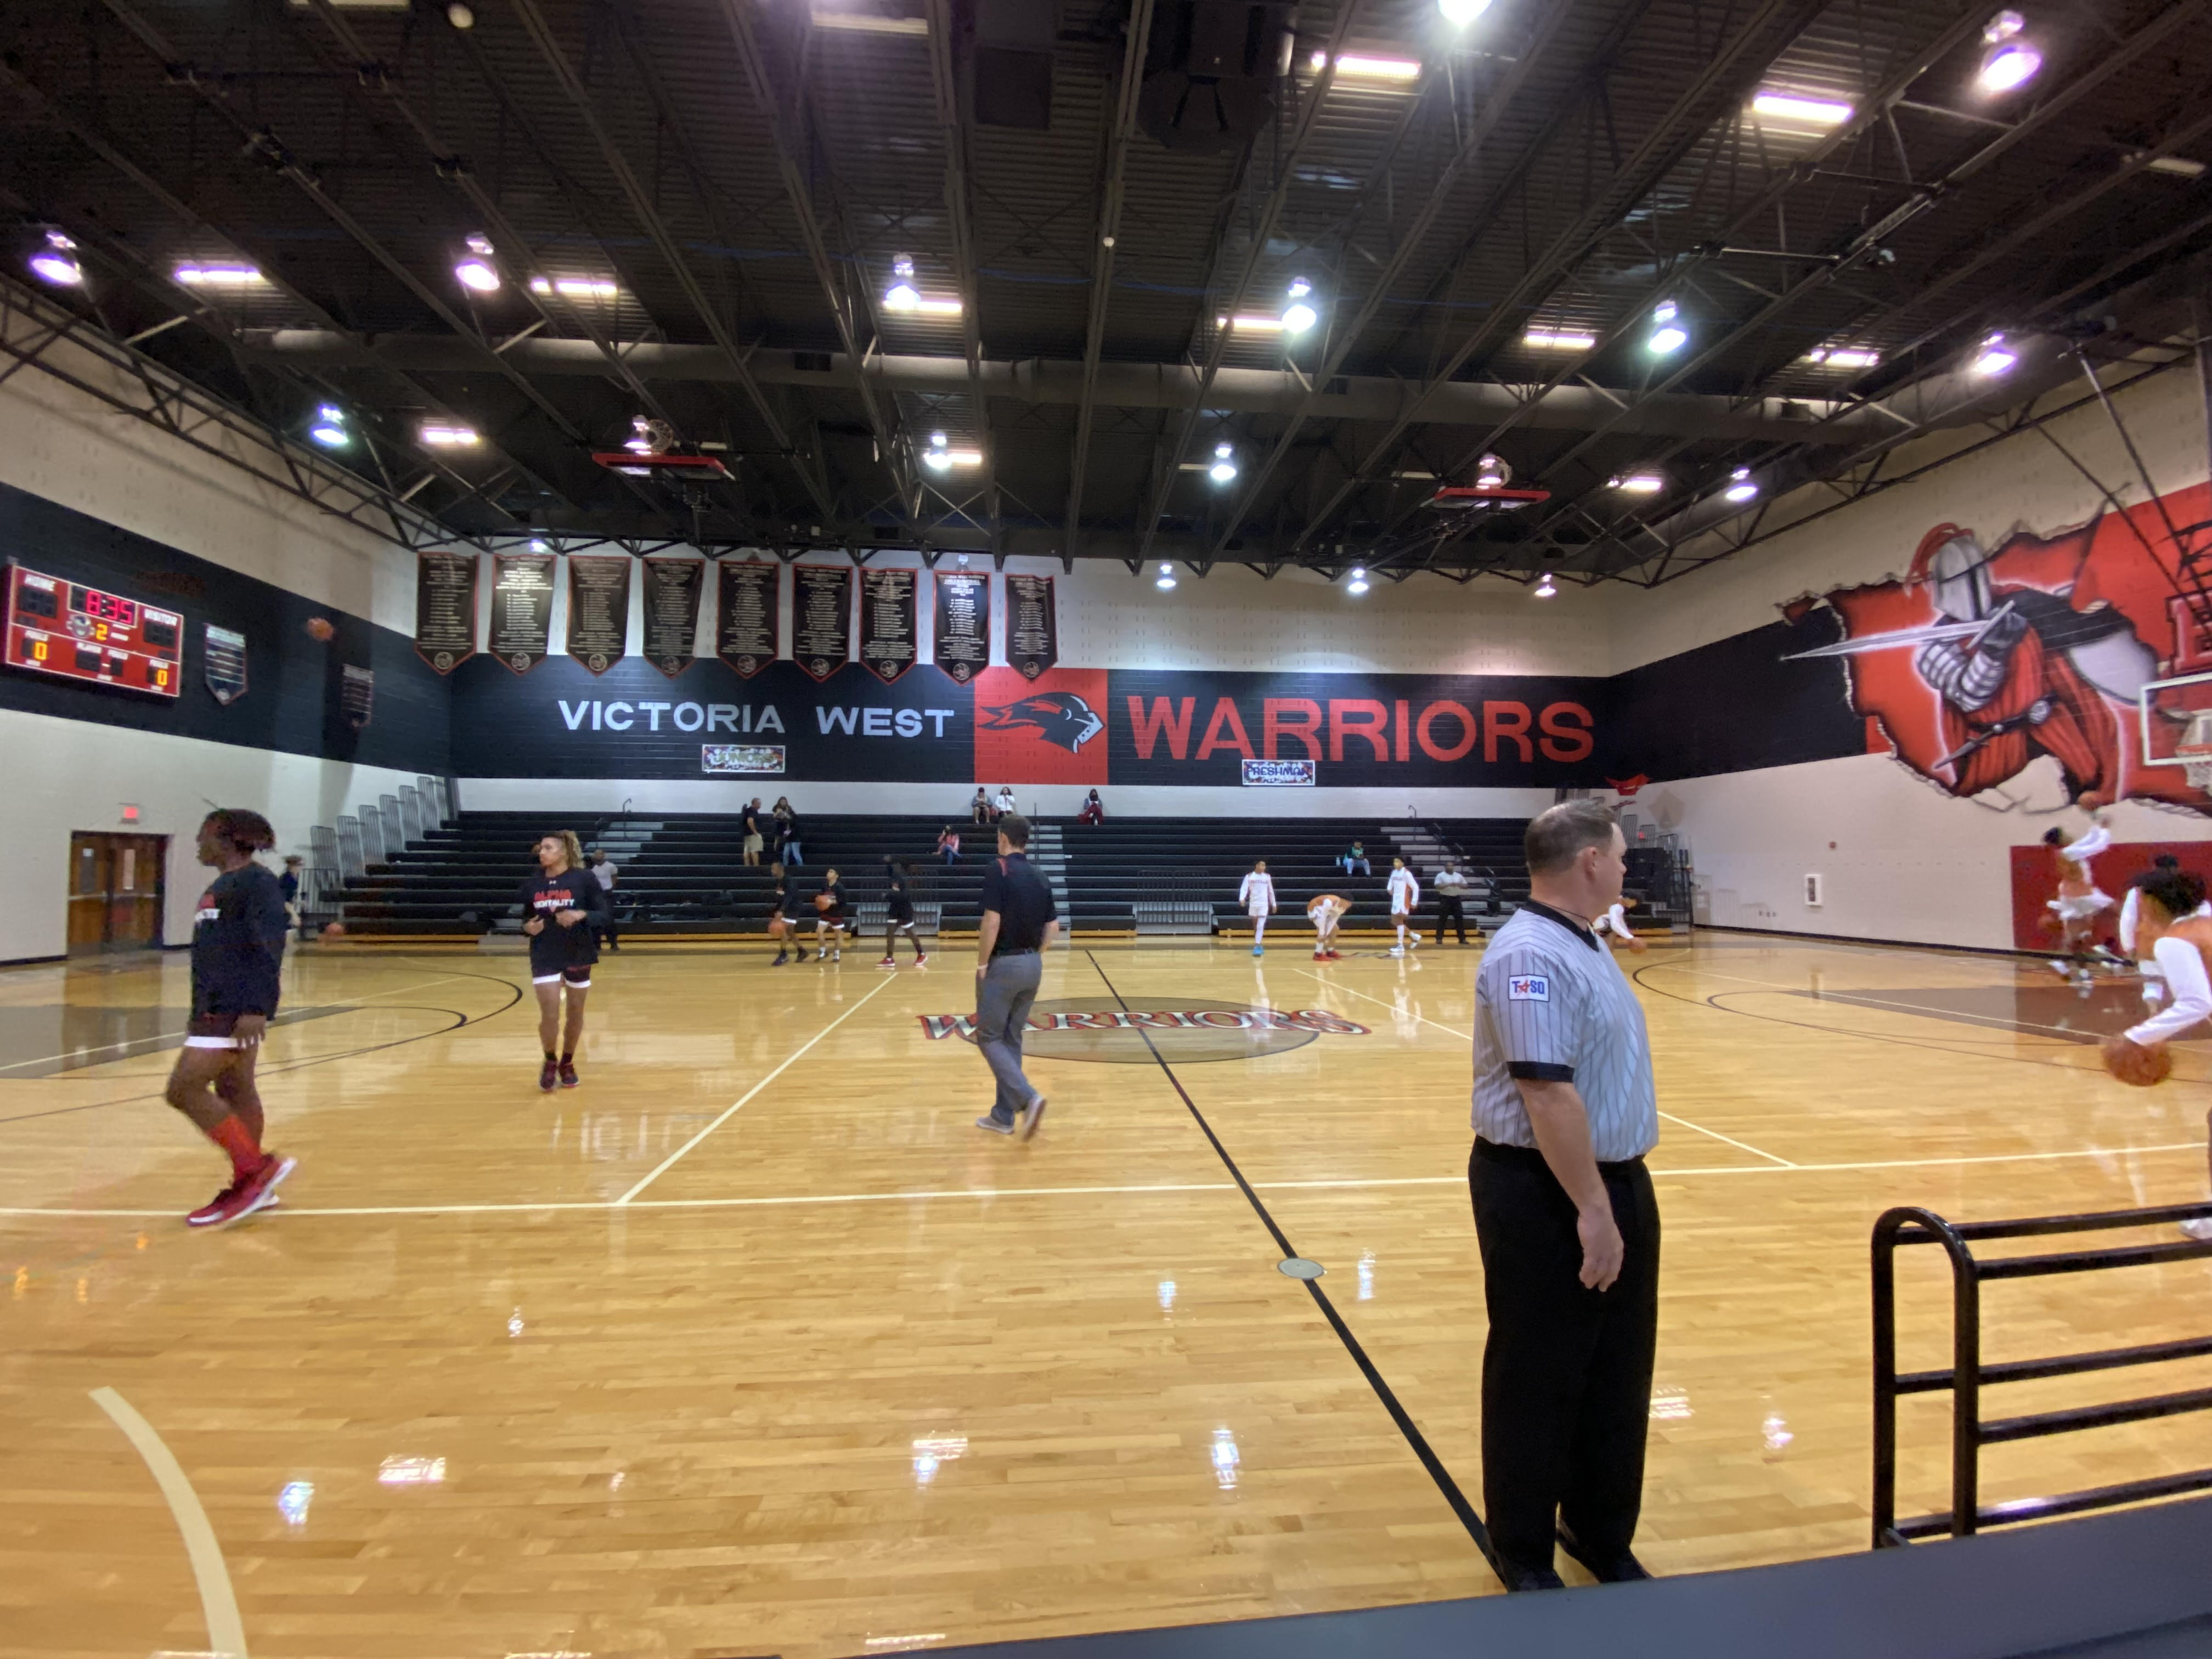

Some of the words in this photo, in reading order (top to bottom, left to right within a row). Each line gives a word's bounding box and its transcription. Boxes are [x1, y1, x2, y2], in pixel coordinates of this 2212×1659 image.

[86, 590, 132, 624] 8:35
[95, 623, 108, 641] 2
[34, 641, 48, 661] 0
[157, 669, 168, 686] 0
[558, 700, 786, 733] VICTORIA
[816, 706, 955, 738] WEST
[1126, 696, 1595, 763] WARRIORS
[917, 1009, 1372, 1040] WRRIORS
